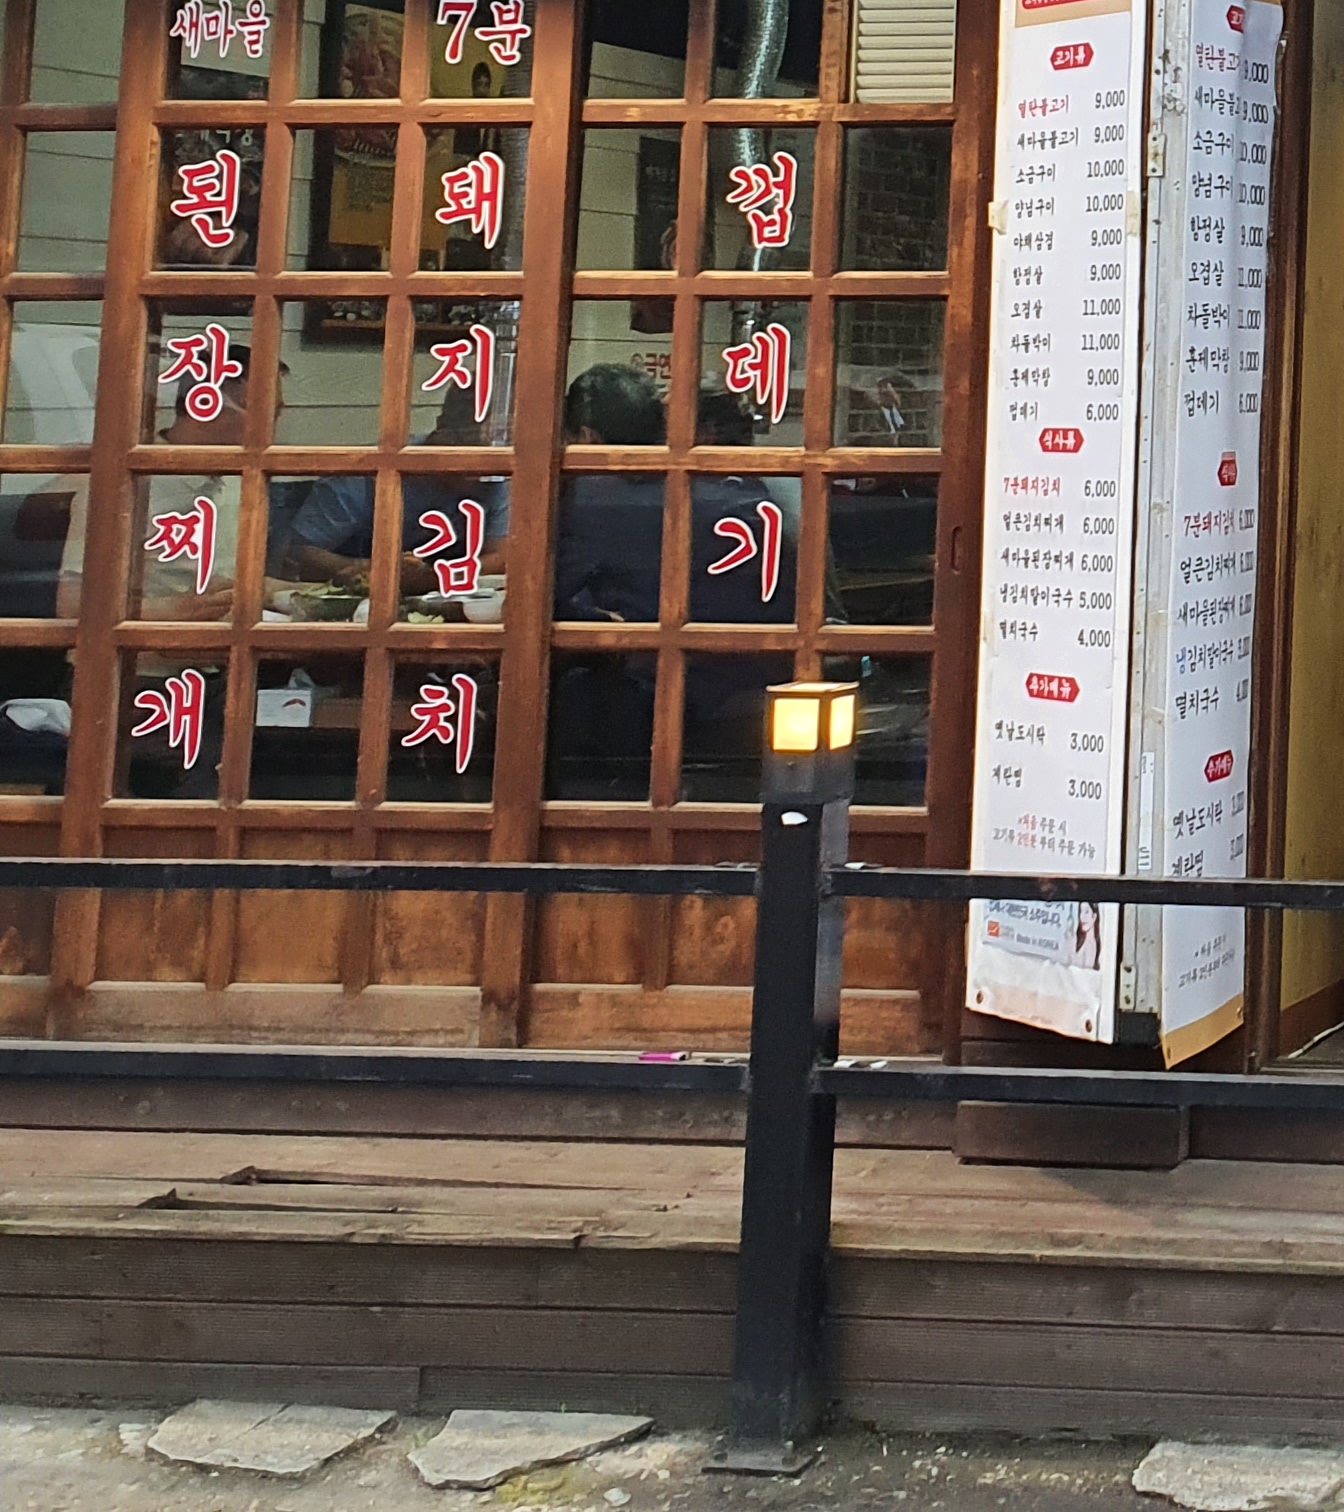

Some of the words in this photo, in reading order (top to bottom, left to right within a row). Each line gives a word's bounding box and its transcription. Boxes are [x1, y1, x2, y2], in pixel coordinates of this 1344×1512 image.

[1053, 45, 1086, 67] 고기류
[1018, 94, 1069, 119] 열탄불고기
[1194, 85, 1240, 116] 새마을불
[1017, 127, 1079, 151] 새마을불고기
[1193, 131, 1234, 157] 소금구이
[1016, 163, 1056, 184] 소금구이
[1087, 159, 1124, 178] 10,000
[1192, 171, 1232, 200] 양념구이
[1015, 197, 1055, 219] 양념구이
[1086, 194, 1123, 213] 10,000
[1091, 228, 1122, 247] 9,000
[1190, 216, 1225, 243] 항정살
[1013, 266, 1043, 285] 항정살
[1090, 263, 1121, 282] 9,000
[1188, 261, 1225, 286] 오겹살
[1011, 300, 1043, 318] 오겹살
[1083, 298, 1120, 317] 11,000
[1187, 303, 1231, 330] 차돌박이
[1010, 333, 1052, 353] 차돌박이
[1081, 333, 1119, 351] 11,000
[1186, 346, 1230, 374] 훈제막창
[708, 152, 797, 602] 껍데기
[1087, 368, 1119, 386] 9,000
[1086, 403, 1118, 421] 6,000
[132, 150, 242, 771] 된장찌개
[402, 151, 504, 773] 돼지김치
[1004, 476, 1061, 497] 7분돼지김치
[1085, 480, 1116, 498] 6,000
[1002, 511, 1064, 534] 얼큰김치찌개
[1083, 517, 1114, 535] 6,000
[1001, 547, 1074, 572] 새마을된장찌개
[1081, 554, 1113, 573] 6,000
[1080, 591, 1112, 610] 5,000
[1078, 629, 1110, 648] 4,000
[1175, 686, 1220, 720] 멸치국수
[995, 719, 1046, 746] 옛날도시락
[1070, 733, 1104, 753] 3,000
[1068, 780, 1102, 800] 3,000
